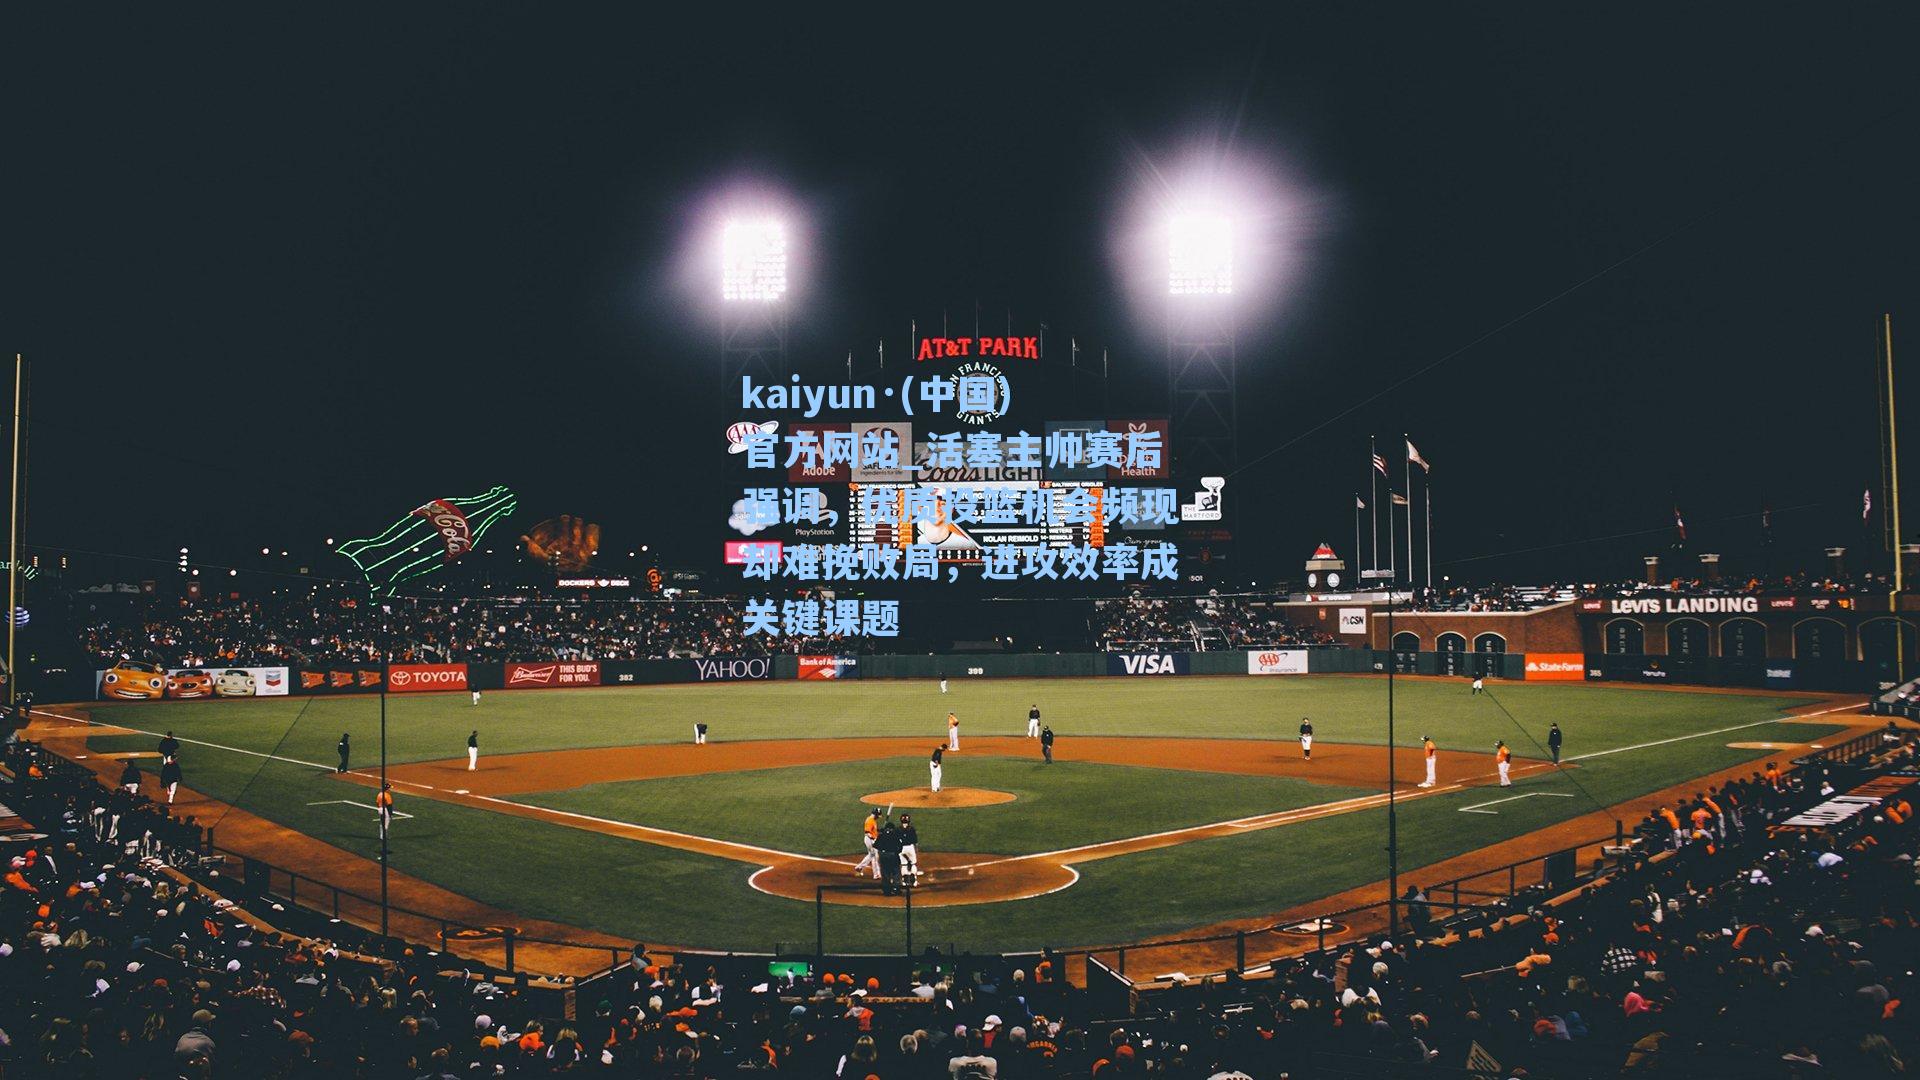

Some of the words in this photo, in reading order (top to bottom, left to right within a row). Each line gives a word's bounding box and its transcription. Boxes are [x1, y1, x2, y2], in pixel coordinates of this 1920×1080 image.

[917, 338, 973, 360] AT&T
[979, 337, 1038, 359] PARK
[802, 463, 836, 476] Adobe
[1121, 465, 1156, 476] Health
[795, 529, 834, 538] PlayStation
[1666, 597, 1759, 613] LANDING
[1349, 616, 1364, 625] CSN
[800, 658, 819, 666] Bank
[826, 658, 857, 666] America
[1119, 654, 1176, 674] VISA
[559, 664, 575, 673] THIS
[576, 664, 598, 673] BUD'S
[695, 658, 771, 681] YAHOO!
[413, 672, 467, 682] TOYOTA
[559, 674, 573, 682] FOR
[574, 674, 591, 682] YOU.
